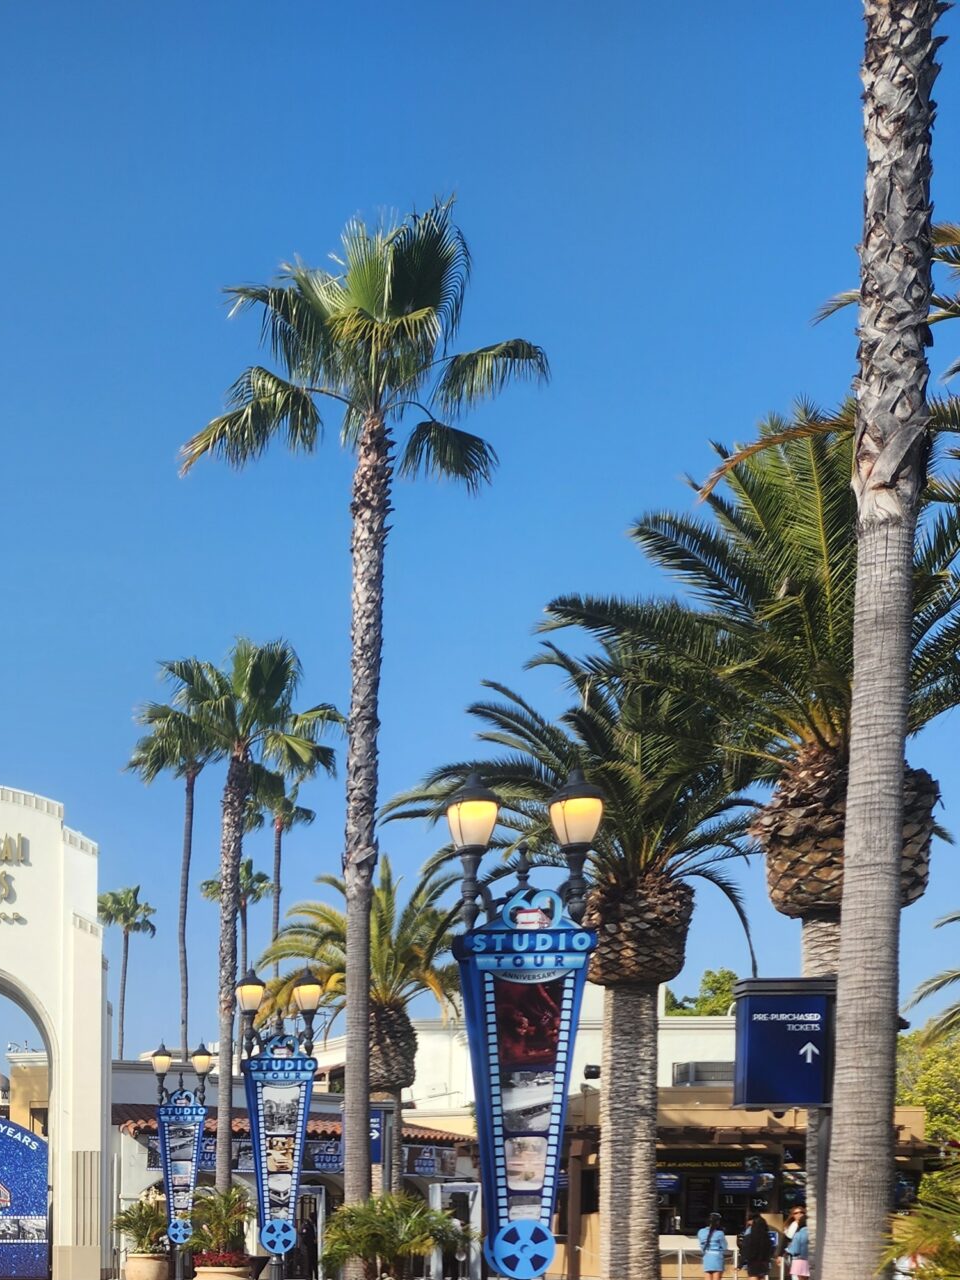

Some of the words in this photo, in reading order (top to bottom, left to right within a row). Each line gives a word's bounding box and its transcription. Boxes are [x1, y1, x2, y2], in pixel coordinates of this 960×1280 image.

[472, 931, 592, 953] STUDIO
[494, 954, 565, 968] TOUR
[501, 970, 558, 981] ANNIVERSARY
[752, 1012, 821, 1021] PRE-PURCHASED
[786, 1023, 821, 1031] TICKETS
[249, 1059, 316, 1071] STUDIO
[262, 1072, 302, 1080] TOUR
[159, 1107, 206, 1115] STUDIO
